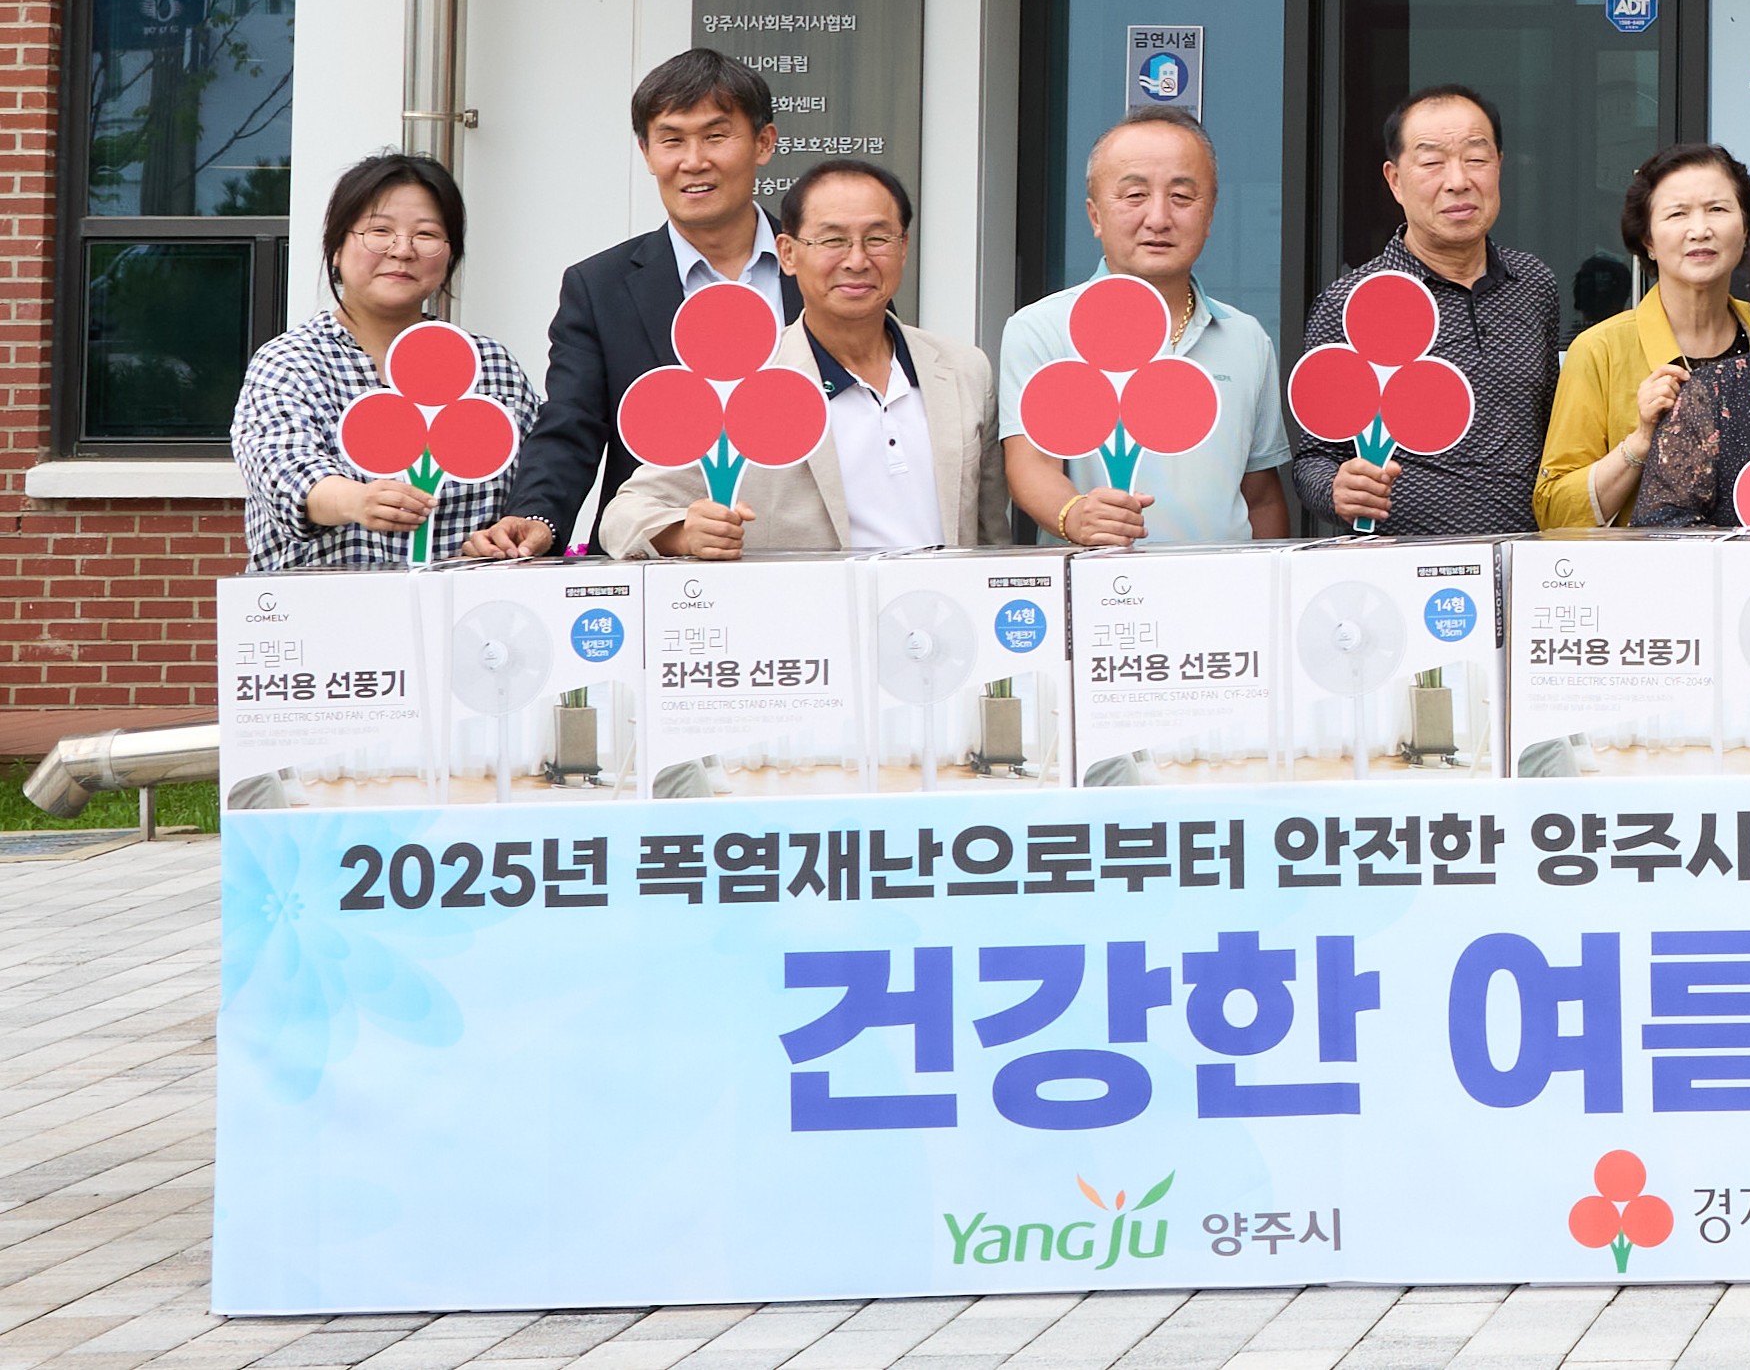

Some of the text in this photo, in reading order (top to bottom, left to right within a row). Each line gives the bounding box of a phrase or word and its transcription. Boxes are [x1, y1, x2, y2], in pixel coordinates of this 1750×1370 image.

[702, 15, 857, 32] 양주시사회복지사협회
[1134, 32, 1196, 48] 금연시설
[672, 601, 714, 609] COMELY
[1101, 598, 1144, 606] COMELY
[1435, 597, 1465, 613] 14형
[246, 614, 289, 622] COMELY
[1005, 608, 1035, 624] 14형
[1531, 606, 1599, 633] 코멜리
[582, 617, 612, 633] 14형
[1440, 629, 1462, 637] 35cm
[662, 627, 728, 655] 코멜리
[1092, 621, 1158, 649] 코멜리
[236, 640, 303, 668] 코멜리
[586, 649, 609, 657] 35cm
[1530, 639, 1700, 665] 좌석용 선풍기
[662, 659, 829, 688] 좌석용 선풍기
[1091, 651, 1259, 682] 좌석용 선풍기
[237, 670, 405, 701] 좌석용 선풍기
[1568, 677, 1608, 686] ELECTRIC
[1609, 677, 1639, 686] STAND
[1641, 677, 1658, 686] FAN
[698, 700, 737, 709] ELECTRIC
[739, 700, 767, 709] STAND
[769, 700, 786, 708] FAN
[1129, 692, 1169, 702] ELECTRIC
[1170, 691, 1199, 701] STAND
[1201, 691, 1218, 700] FAN
[274, 712, 314, 722] ELECTRIC
[315, 712, 343, 721] STAND
[346, 711, 363, 720] FAN
[339, 835, 610, 911] 2025년
[636, 818, 1246, 906] 폭염재난으로부터
[1273, 812, 1504, 889] 안전한
[778, 929, 1381, 1132] 건강한
[1202, 1207, 1342, 1257] 양주시
